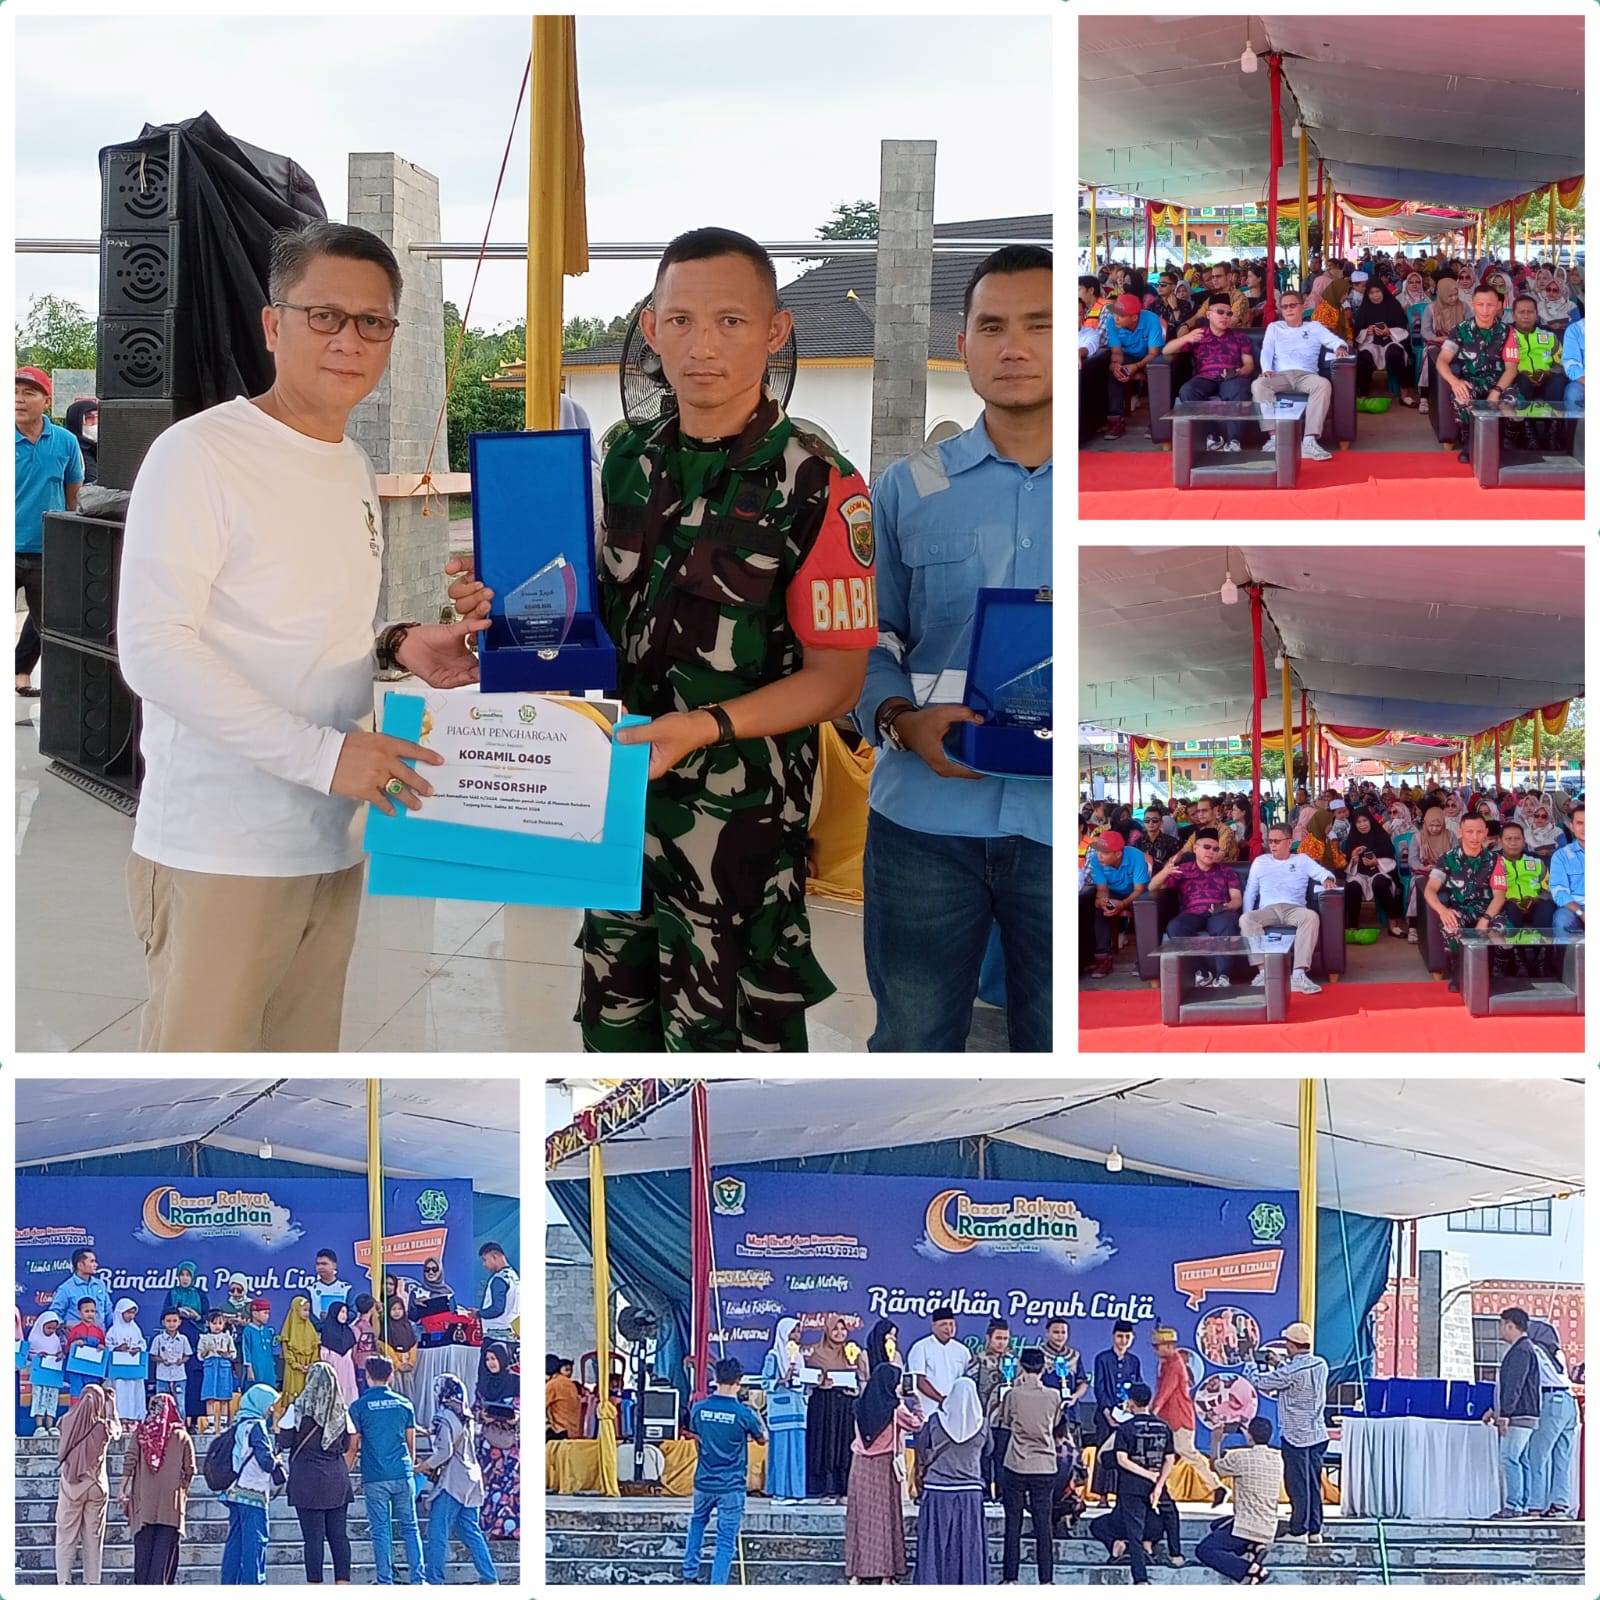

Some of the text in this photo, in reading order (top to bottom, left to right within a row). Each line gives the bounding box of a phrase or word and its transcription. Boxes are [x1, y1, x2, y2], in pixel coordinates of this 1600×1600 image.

[447, 726, 567, 742] PIAGAM PENGHARGAAN
[459, 750, 551, 765] KORAMIL 0405
[459, 779, 547, 794] SPONSORSHIP
[170, 1192, 268, 1208] Bazar Rakyat
[958, 1197, 1074, 1217] Bazar Rakyat
[170, 1206, 272, 1224] Ramadhan
[958, 1216, 1077, 1238] Ramadhan
[1007, 1290, 1087, 1324] Penuh
